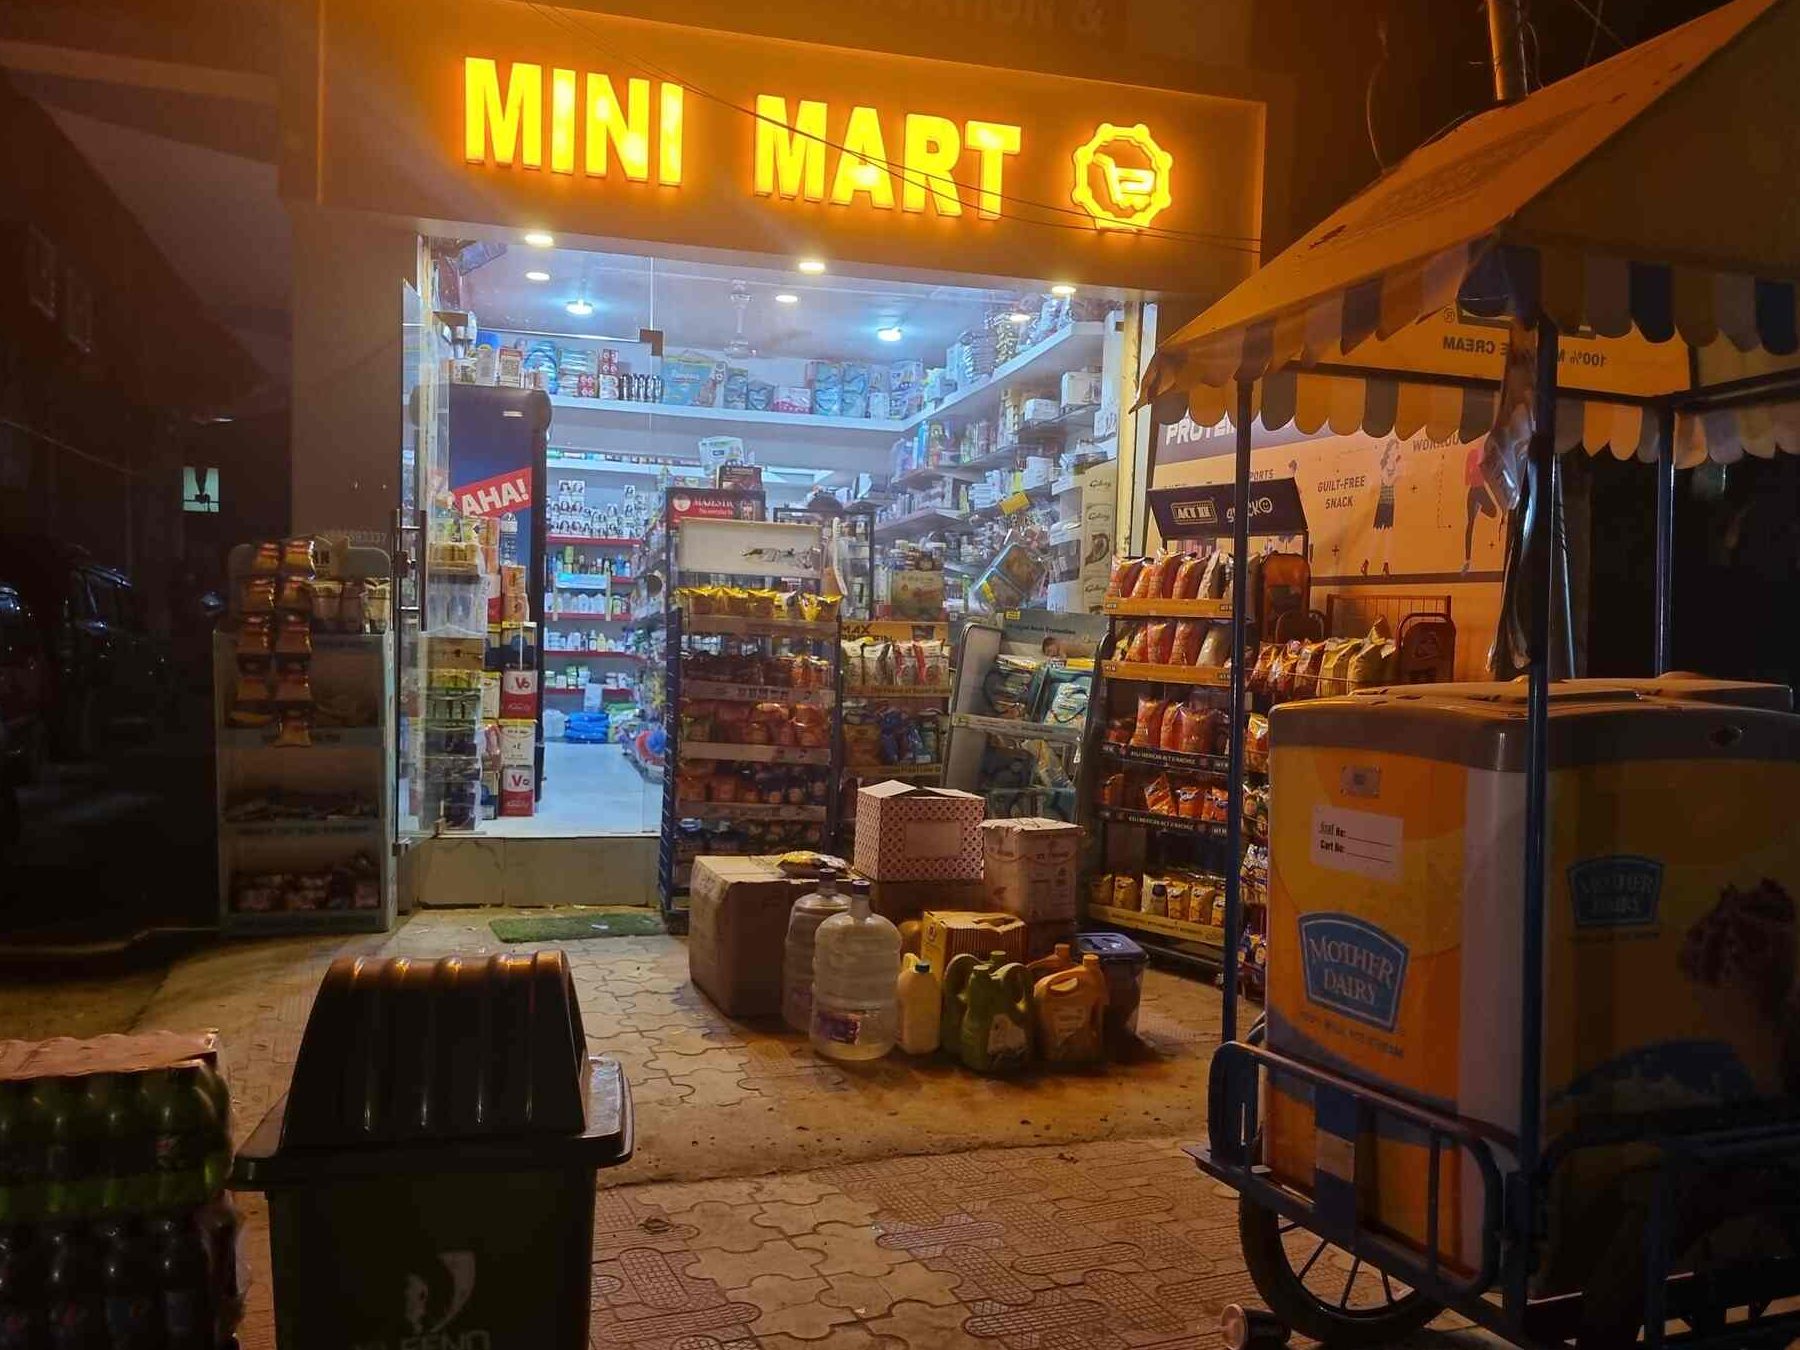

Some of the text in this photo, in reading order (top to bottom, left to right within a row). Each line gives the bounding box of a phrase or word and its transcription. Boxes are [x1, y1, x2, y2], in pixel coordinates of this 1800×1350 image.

[464, 56, 1023, 221] MINI MART
[461, 477, 530, 517] AHA!
[1317, 475, 1367, 494] GUILT-FREE
[1325, 495, 1354, 510] SNACK
[1309, 935, 1394, 990] MOTHER
[1323, 968, 1378, 1006] DAIRY
